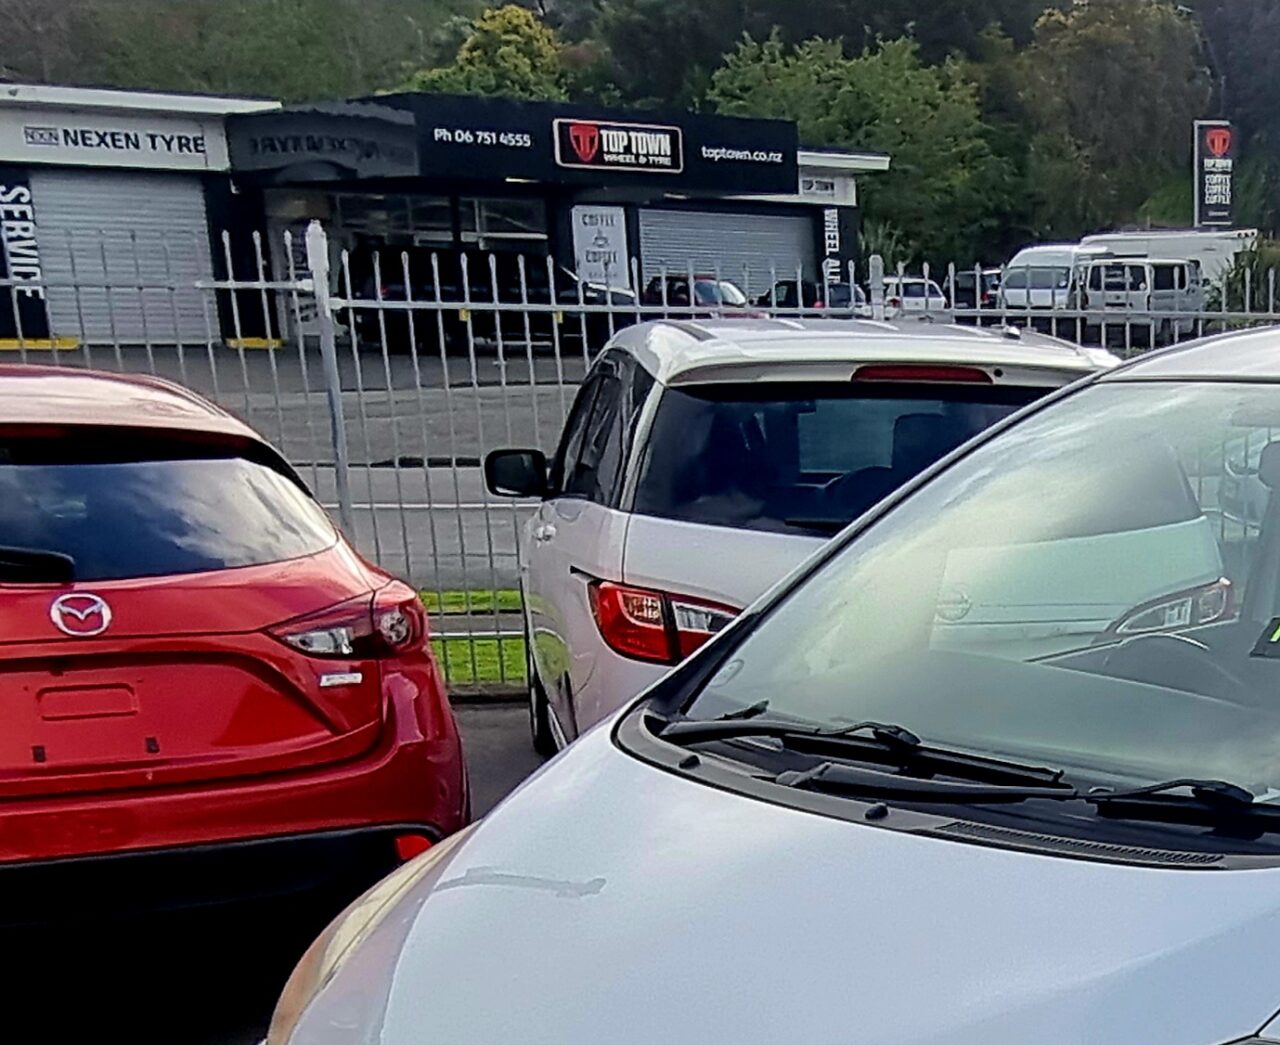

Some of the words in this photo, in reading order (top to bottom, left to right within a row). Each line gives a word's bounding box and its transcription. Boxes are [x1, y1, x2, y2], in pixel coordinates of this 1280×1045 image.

[63, 129, 140, 150] NEXEN
[146, 133, 206, 153] TYRE
[434, 128, 452, 142] Ph
[454, 129, 474, 143] 06
[476, 131, 497, 145] 751
[500, 133, 531, 147] 4555
[600, 129, 628, 153] TOP
[629, 132, 671, 156] TOWN
[604, 154, 637, 164] WHEEL
[649, 156, 672, 166] TYRE
[702, 146, 783, 163] toptown.co.nz
[0, 185, 47, 300] SERVICE
[824, 208, 840, 256] WHEEL
